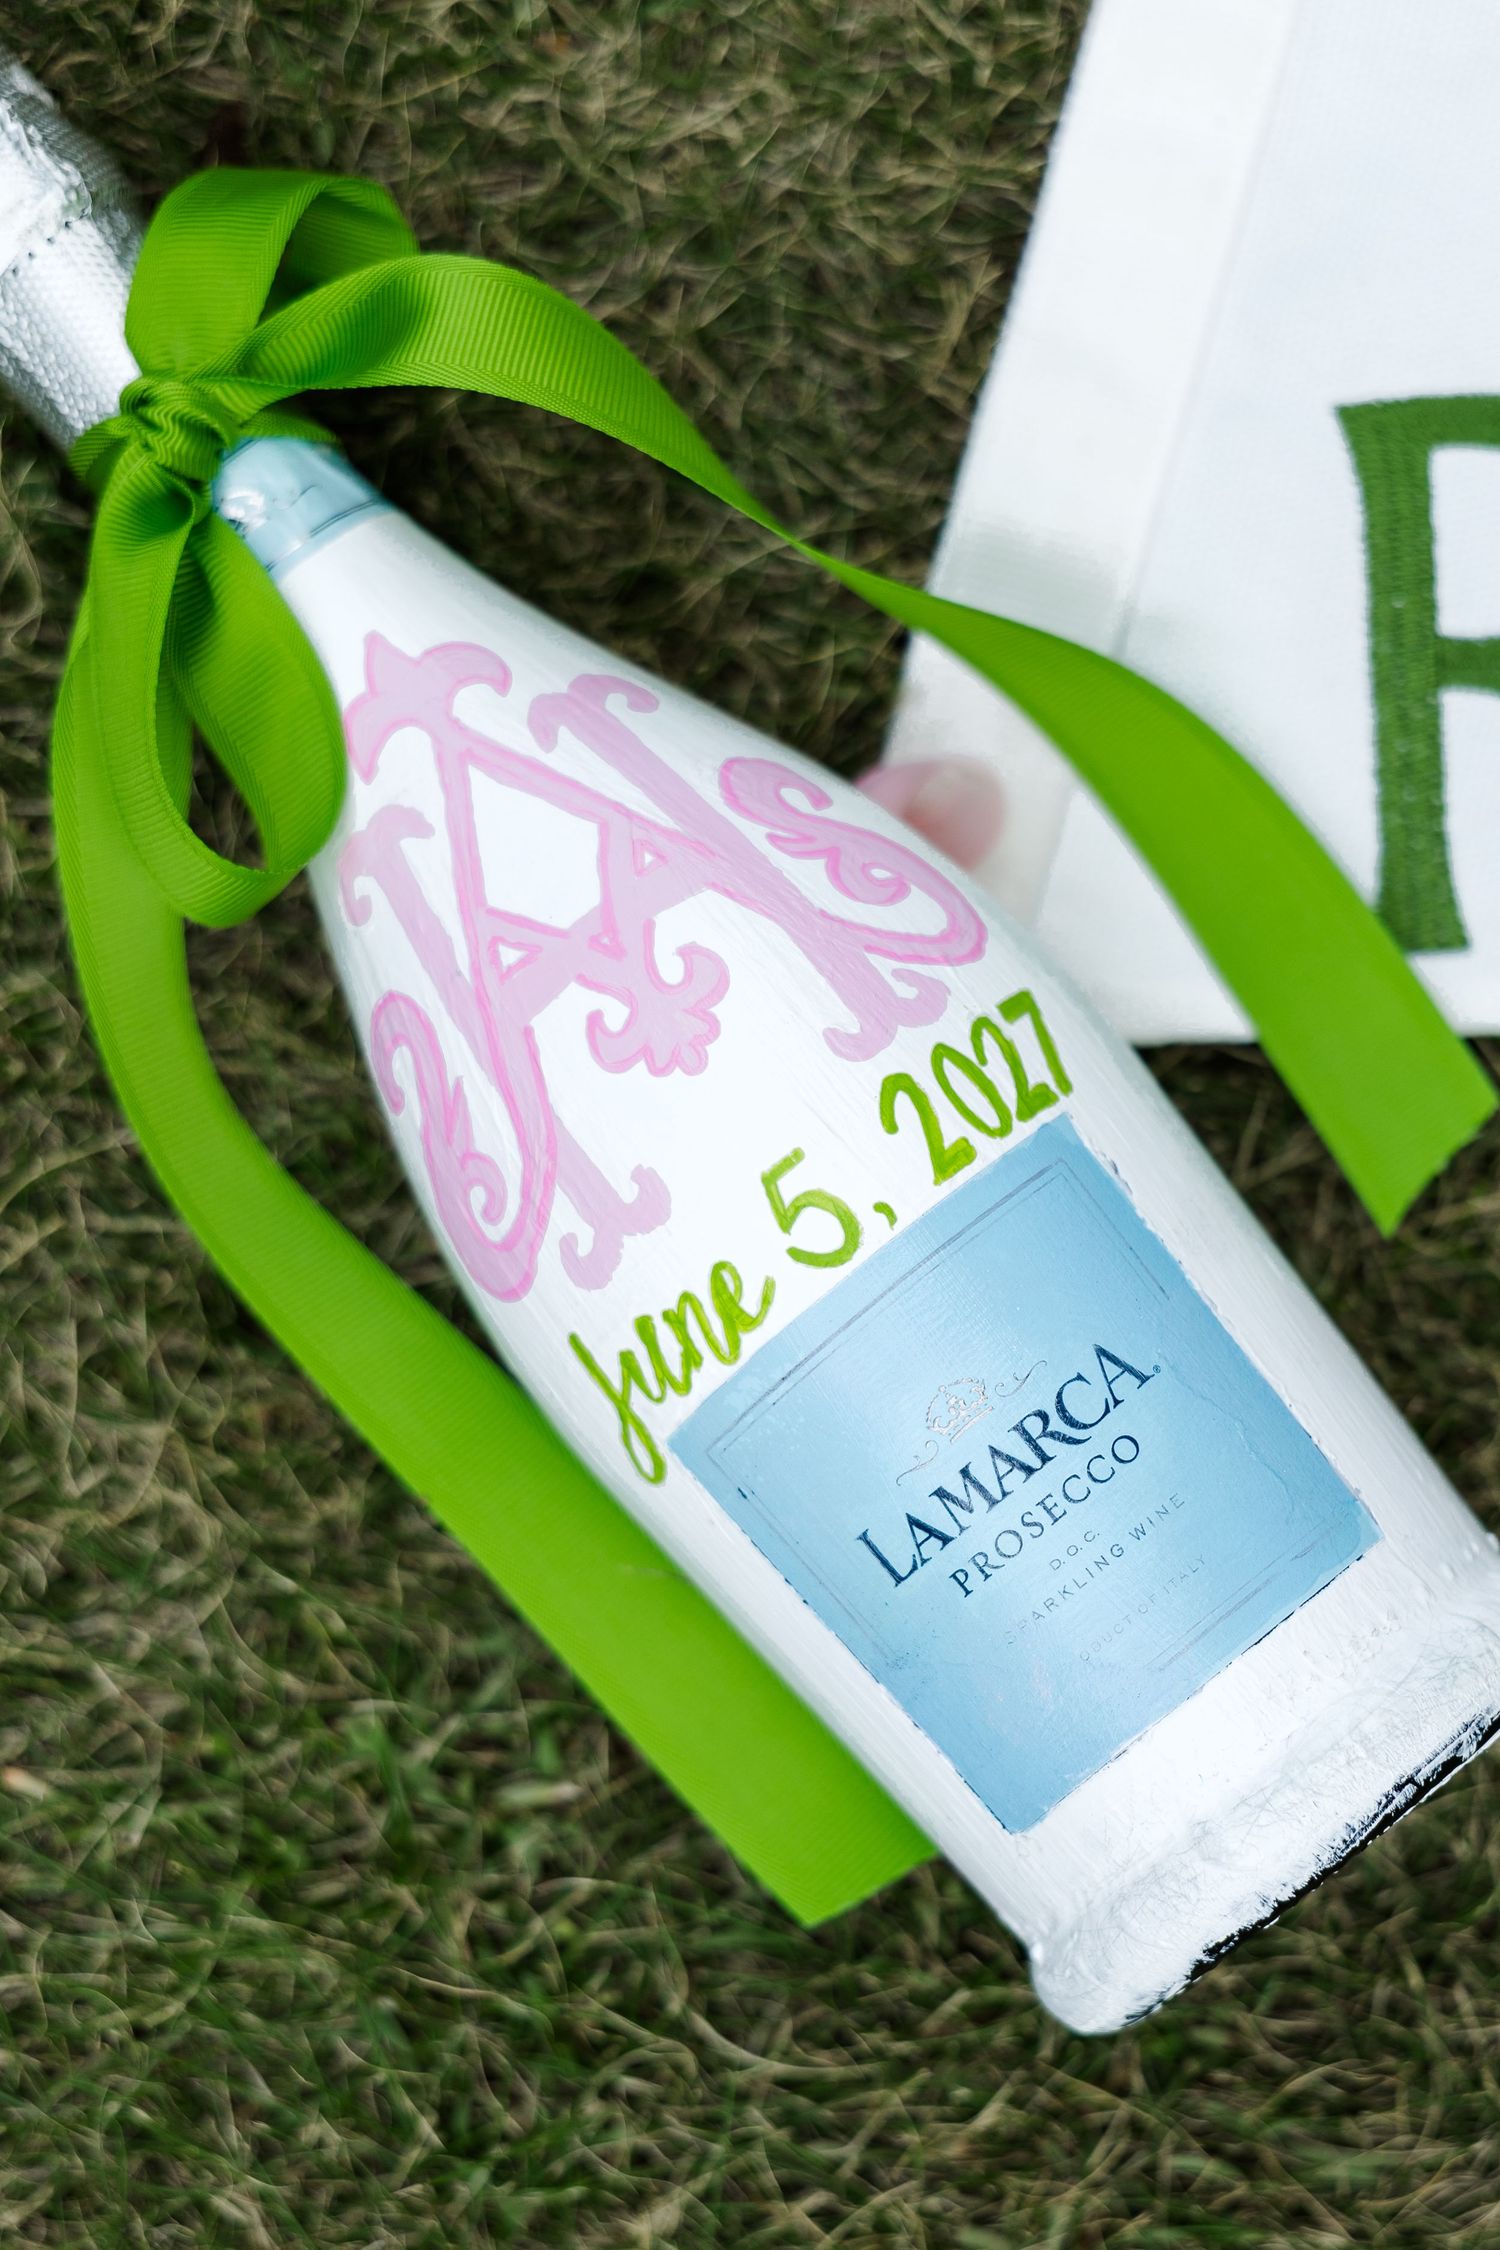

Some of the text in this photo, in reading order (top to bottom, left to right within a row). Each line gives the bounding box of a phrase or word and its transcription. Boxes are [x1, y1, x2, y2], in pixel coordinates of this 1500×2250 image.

[568, 988, 1073, 1485] June 5, 2027
[949, 1434, 1140, 1598] PROSECCO
[1128, 1492, 1185, 1542] WINE
[1162, 1553, 1207, 1595] ITALY
